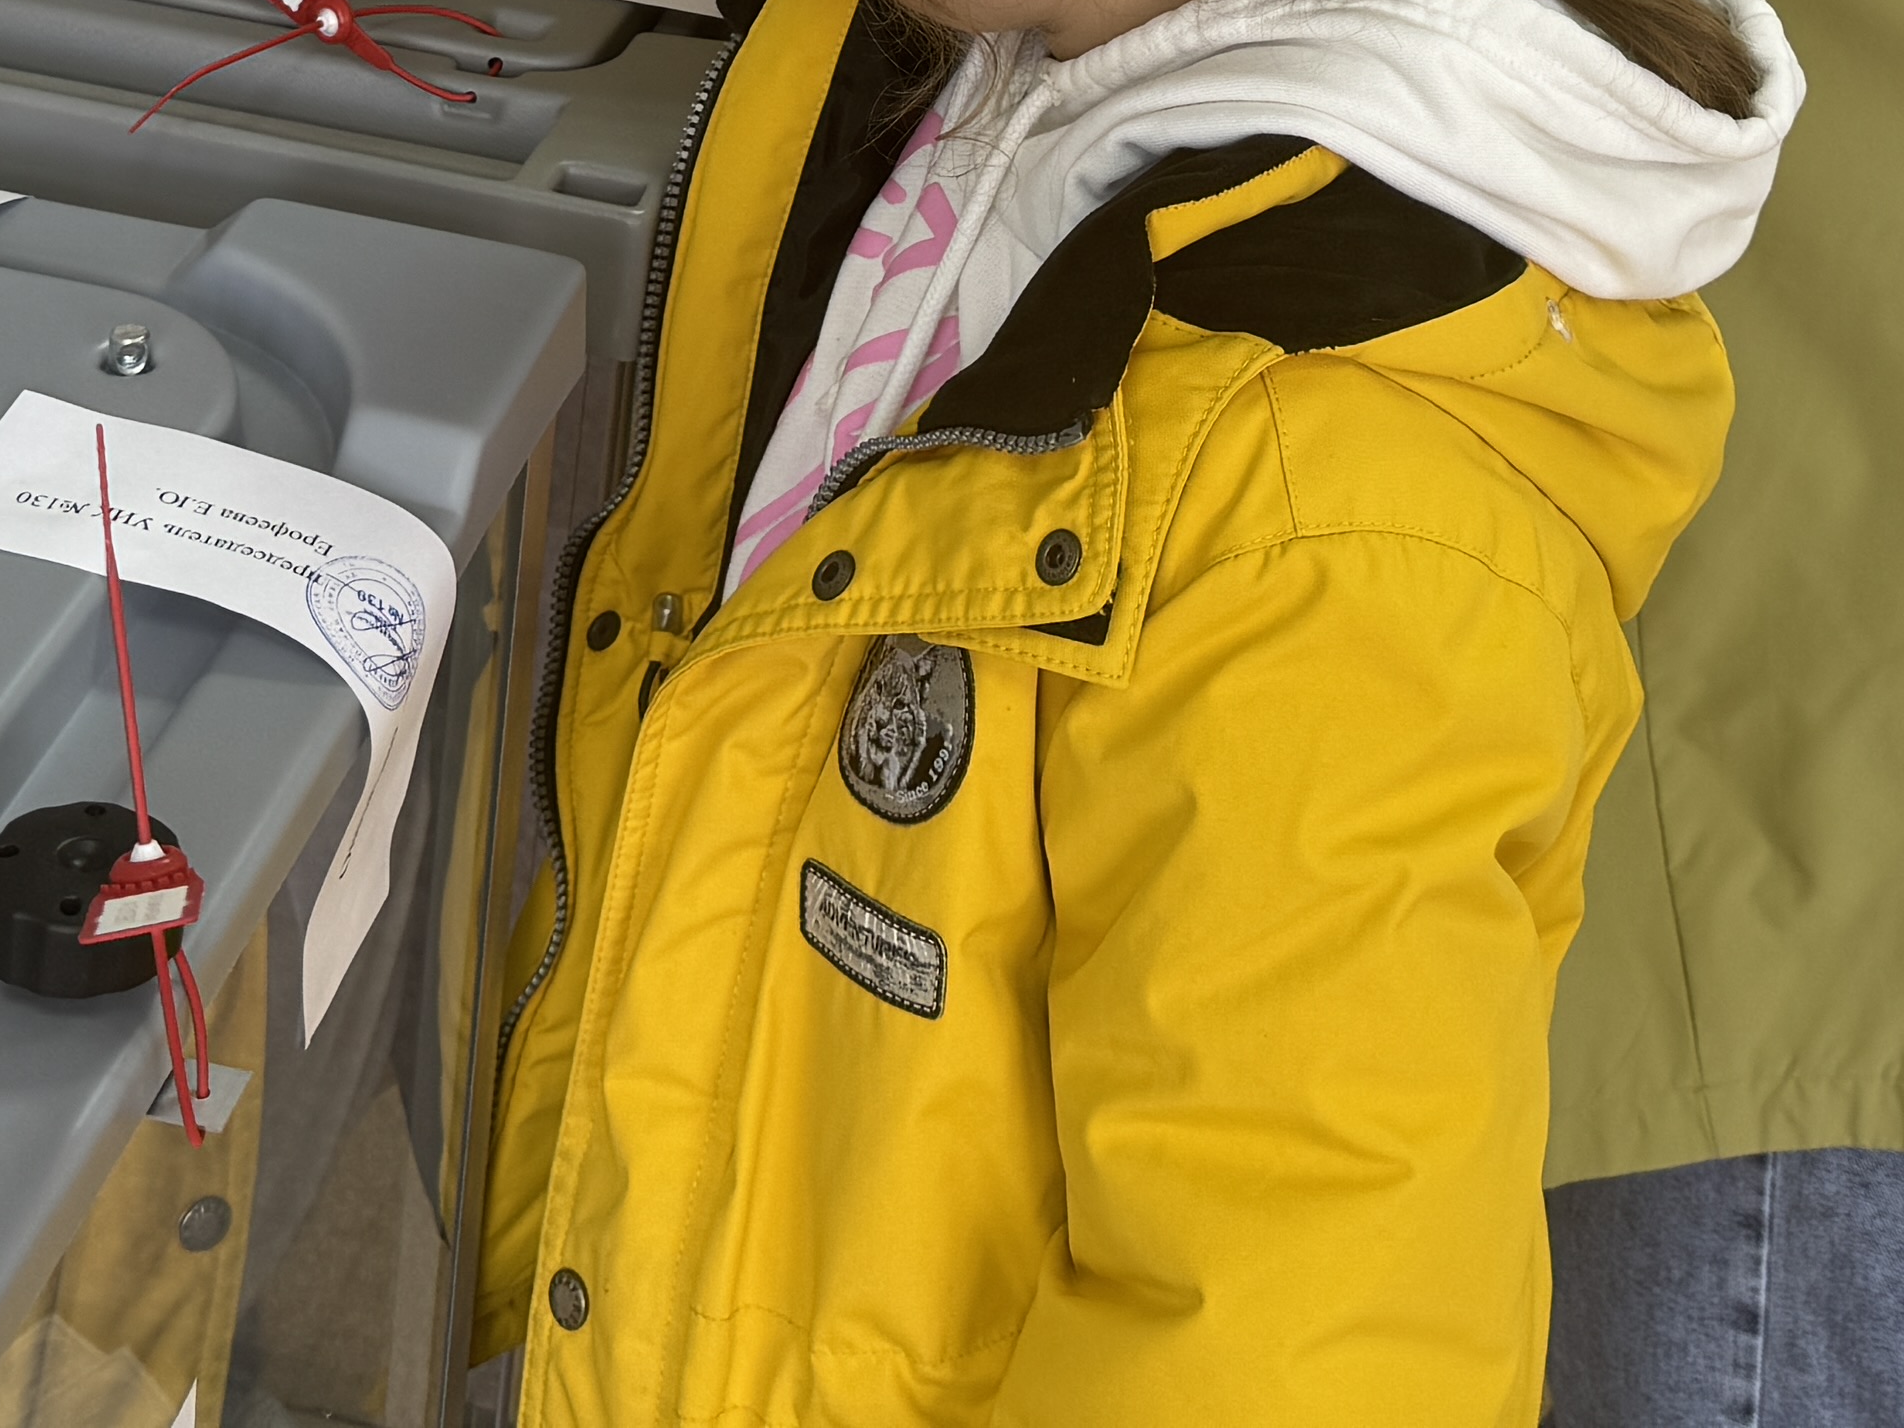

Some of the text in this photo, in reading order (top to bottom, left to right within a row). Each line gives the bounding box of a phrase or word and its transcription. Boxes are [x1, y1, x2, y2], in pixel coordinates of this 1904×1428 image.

[16, 491, 90, 514] №130
[156, 487, 336, 557] Ерофеева Е.Ю.
